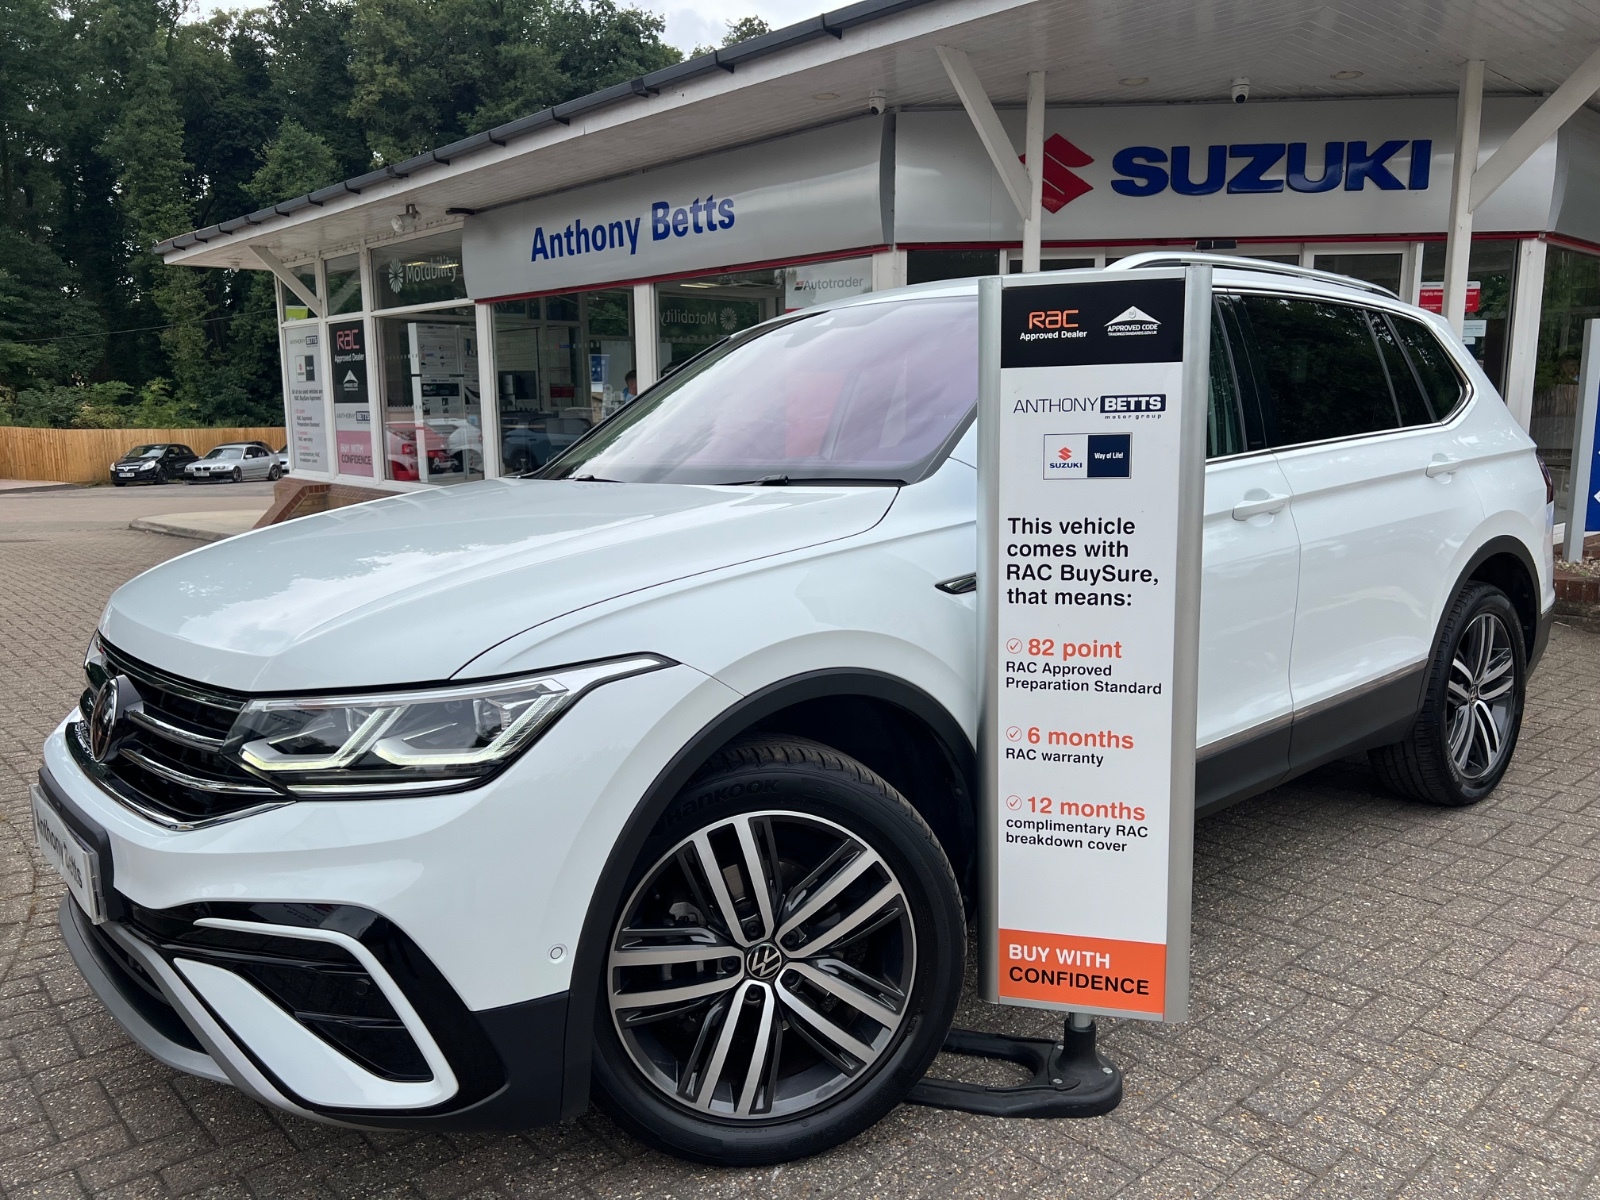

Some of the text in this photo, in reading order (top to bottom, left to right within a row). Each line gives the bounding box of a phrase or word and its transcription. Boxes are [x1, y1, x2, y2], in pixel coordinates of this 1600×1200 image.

[1110, 139, 1432, 197] SUZUKI
[531, 194, 736, 262] Anthony Betts
[405, 255, 458, 284] Motability
[803, 276, 864, 291] Autotrader
[1020, 330, 1088, 341] Approved Dealer
[1107, 324, 1141, 332] APPROVED
[334, 352, 365, 364] Approved Dealer
[1013, 396, 1162, 414] ANTHONY BETTS
[340, 443, 364, 453] BUY WITH
[1094, 452, 1106, 460] Way
[341, 454, 372, 465] CONFIDENCE
[1007, 517, 1136, 535] This vehicle
[1006, 540, 1129, 557] comes with
[1006, 563, 1159, 586] RAC BuySure,
[1006, 587, 1132, 607] that means:
[1028, 638, 1123, 661] 82 point
[1006, 661, 1112, 677] RAC Approved
[1006, 677, 1162, 695] Preparation Standard
[1027, 726, 1134, 749] 6 months
[1006, 747, 1104, 767] RAC warranty
[1027, 796, 1146, 821] 12 months
[1006, 819, 1149, 838] complimentary RAC
[36, 808, 83, 889] Anthony Betts
[1006, 831, 1128, 852] breakdown cover
[1008, 943, 1111, 969] BUY WITH
[1009, 966, 1150, 996] CONFIDENCE
